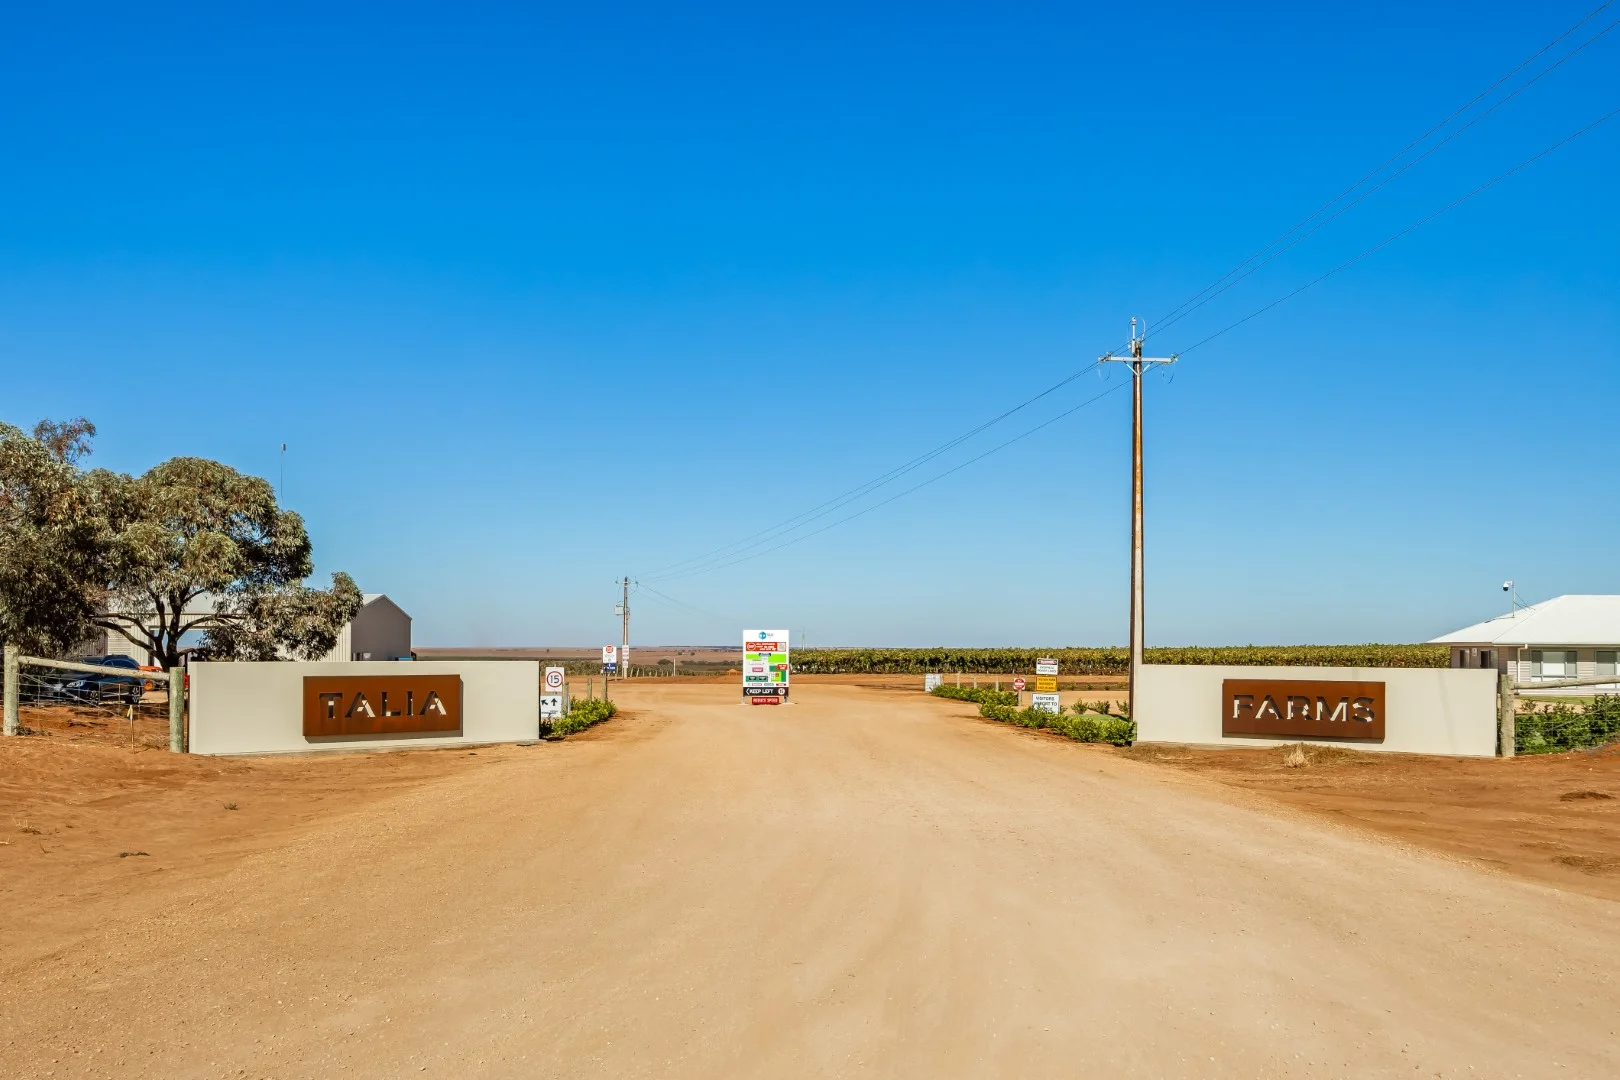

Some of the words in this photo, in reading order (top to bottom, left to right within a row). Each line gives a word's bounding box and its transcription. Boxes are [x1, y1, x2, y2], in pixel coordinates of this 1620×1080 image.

[550, 674, 560, 684] 15
[319, 691, 447, 718] TALIA
[1233, 695, 1375, 723] FARMS
